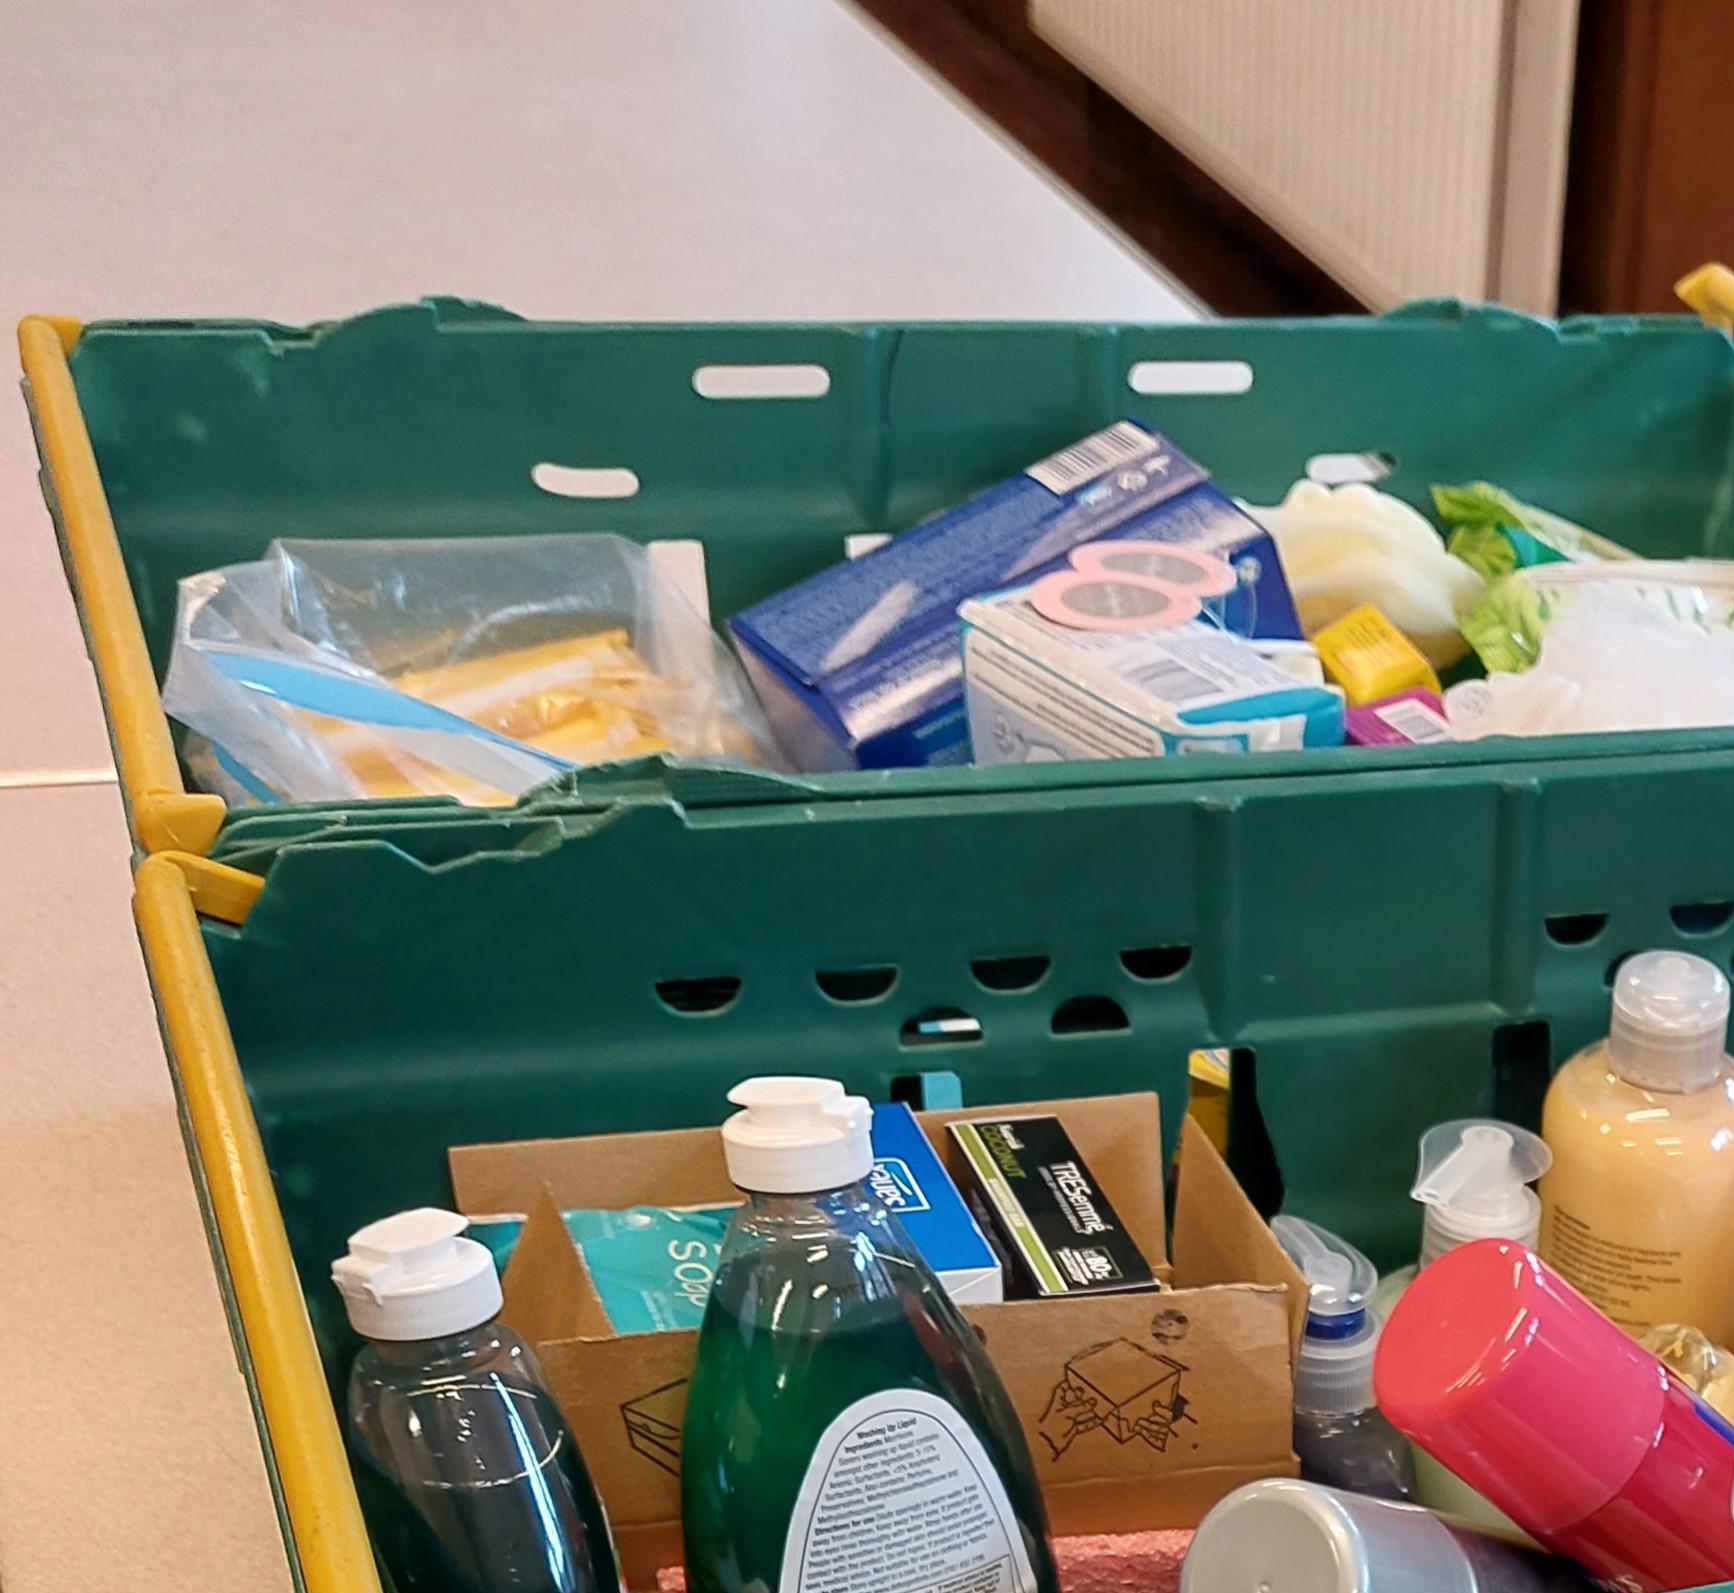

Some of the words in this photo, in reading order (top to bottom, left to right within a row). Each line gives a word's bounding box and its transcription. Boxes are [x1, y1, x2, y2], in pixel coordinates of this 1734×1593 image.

[980, 1126, 1026, 1179] COCONUT
[1050, 1161, 1114, 1235] TRESemmé
[857, 1425, 886, 1440] Washing
[897, 1418, 917, 1430] Liquid
